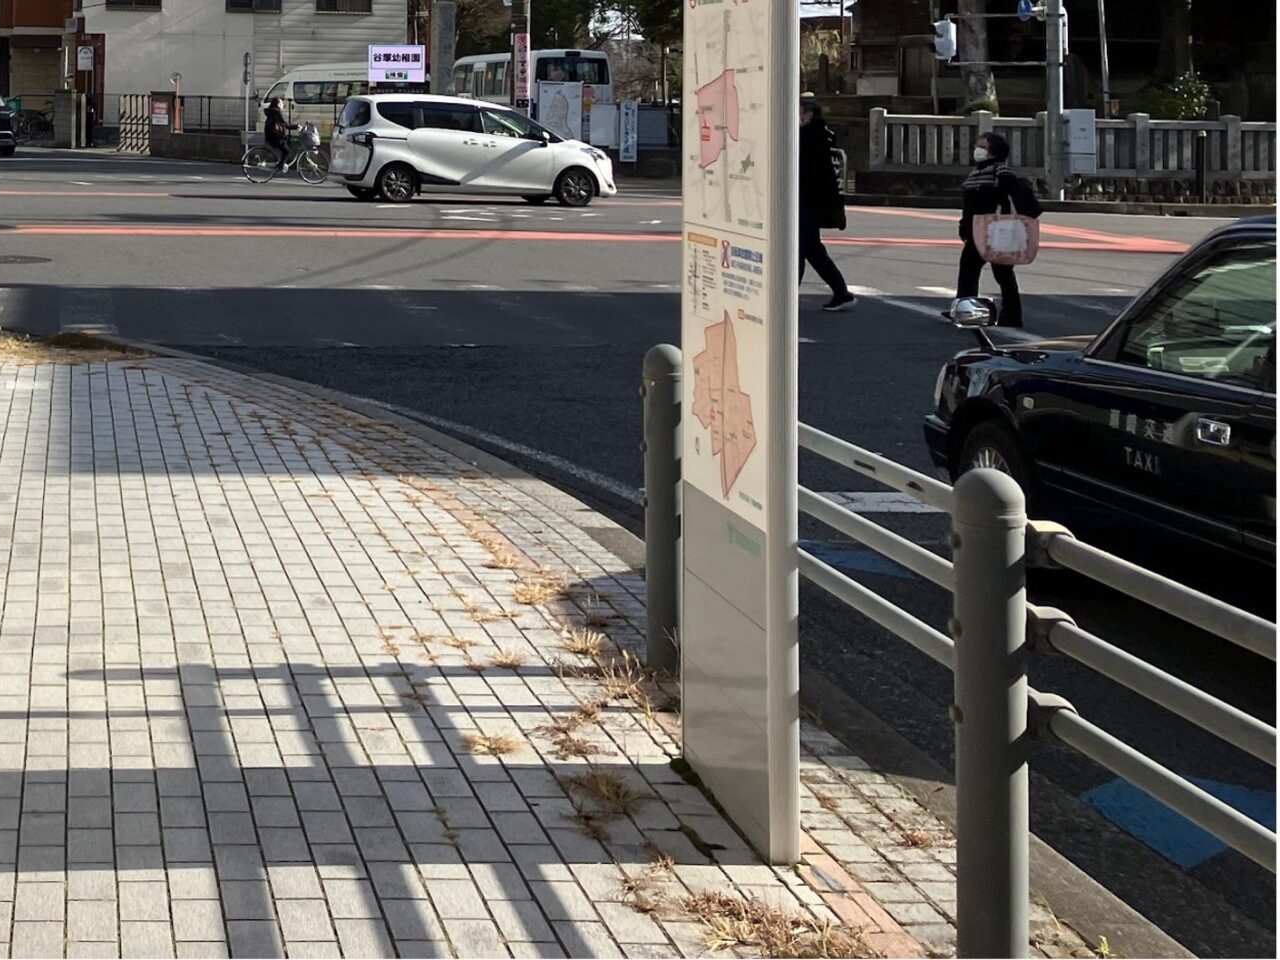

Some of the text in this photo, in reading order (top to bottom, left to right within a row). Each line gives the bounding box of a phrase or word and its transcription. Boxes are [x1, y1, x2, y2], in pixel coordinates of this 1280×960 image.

[372, 52, 421, 63] 谷塚幼稚園
[1123, 445, 1159, 475] TAXI
